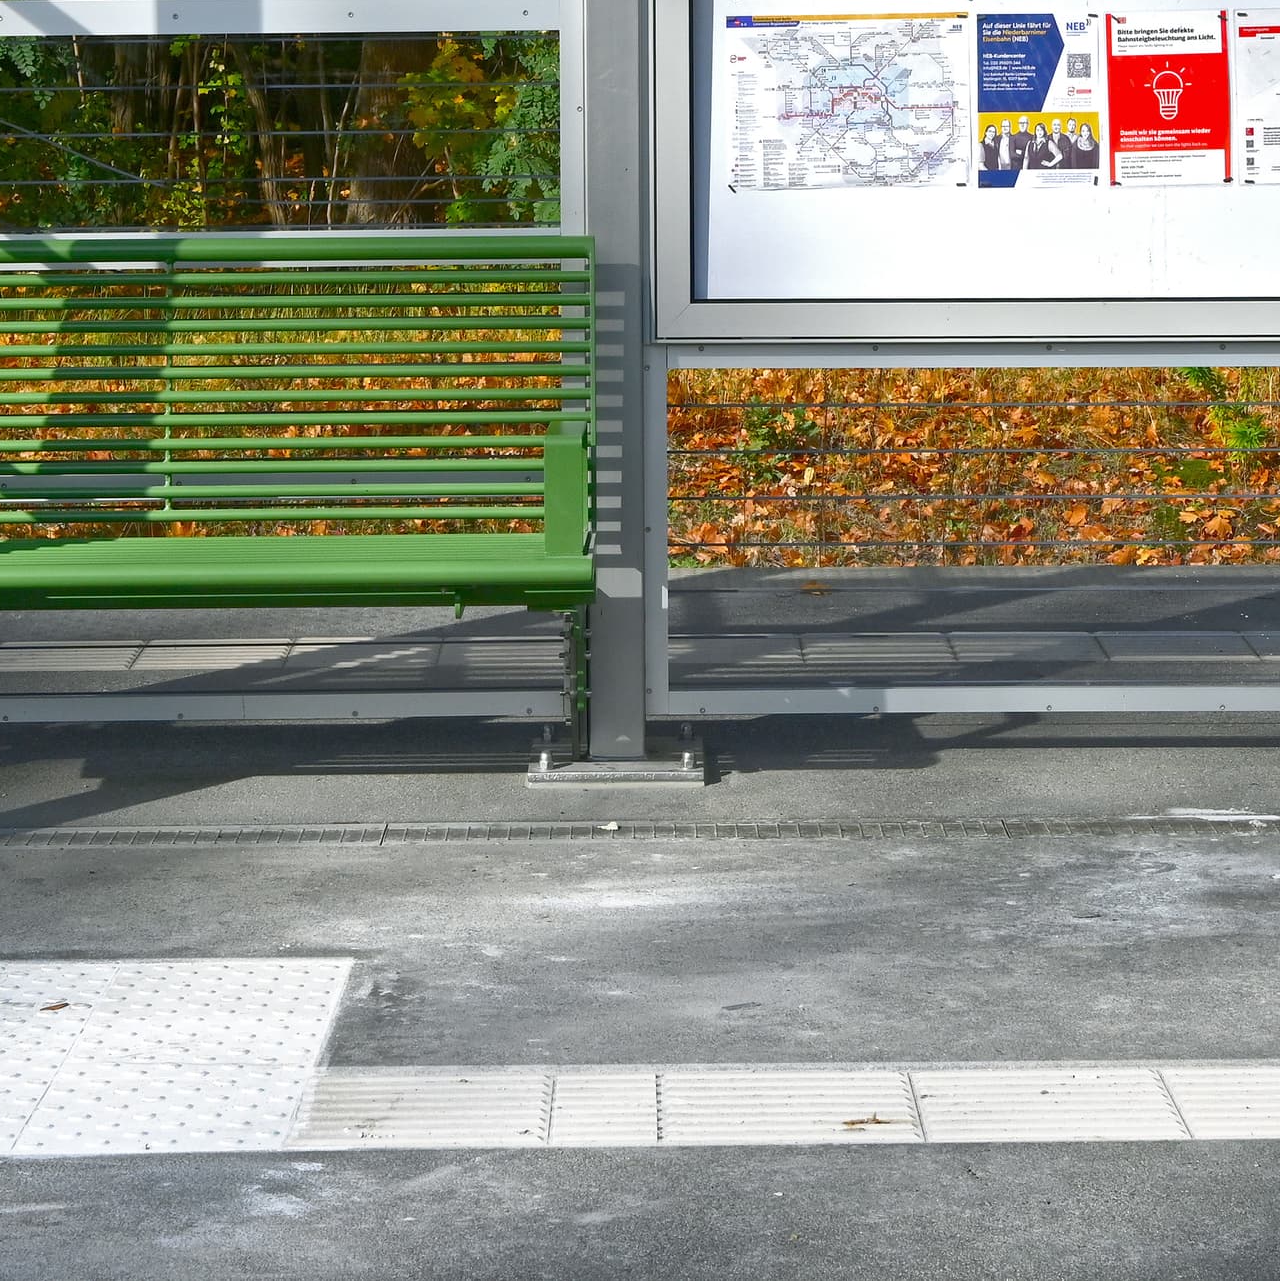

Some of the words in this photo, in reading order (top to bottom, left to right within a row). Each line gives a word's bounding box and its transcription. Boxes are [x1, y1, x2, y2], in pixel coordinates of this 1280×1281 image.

[1066, 22, 1086, 30] NEB
[1012, 35, 1029, 43] (NEB)
[1117, 35, 1186, 43] Bahnsteigbeleuchtung
[1158, 128, 1190, 136] gemeinsam
